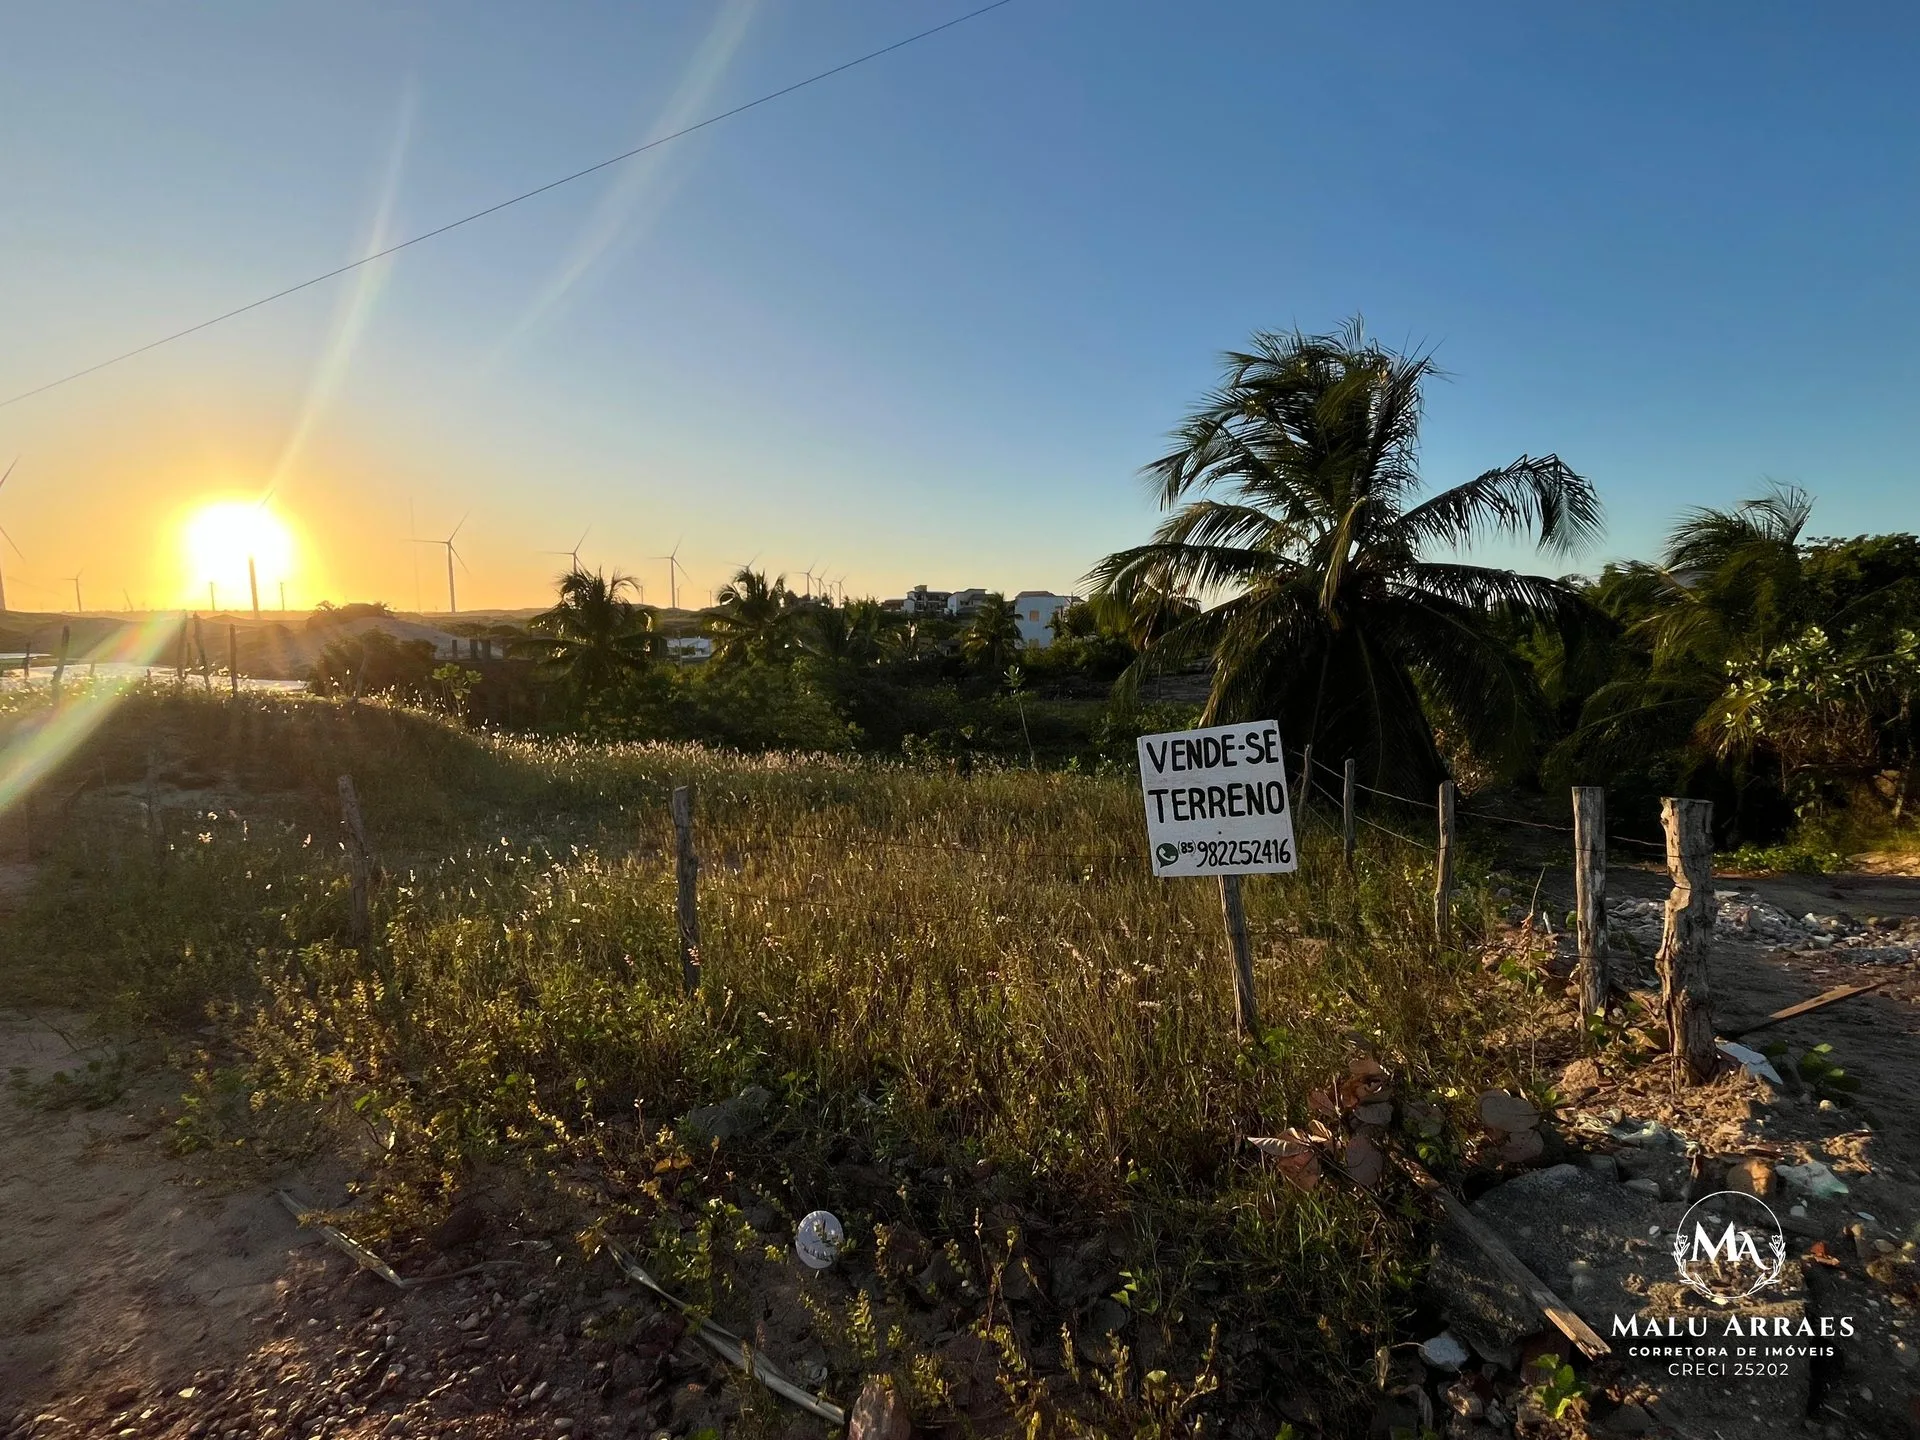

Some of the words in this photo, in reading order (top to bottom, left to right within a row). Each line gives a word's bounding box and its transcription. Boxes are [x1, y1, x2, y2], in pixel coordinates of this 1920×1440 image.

[1146, 729, 1279, 774] VENDE-SE
[1147, 781, 1285, 824] TERRENO
[1196, 838, 1291, 868] 982252416
